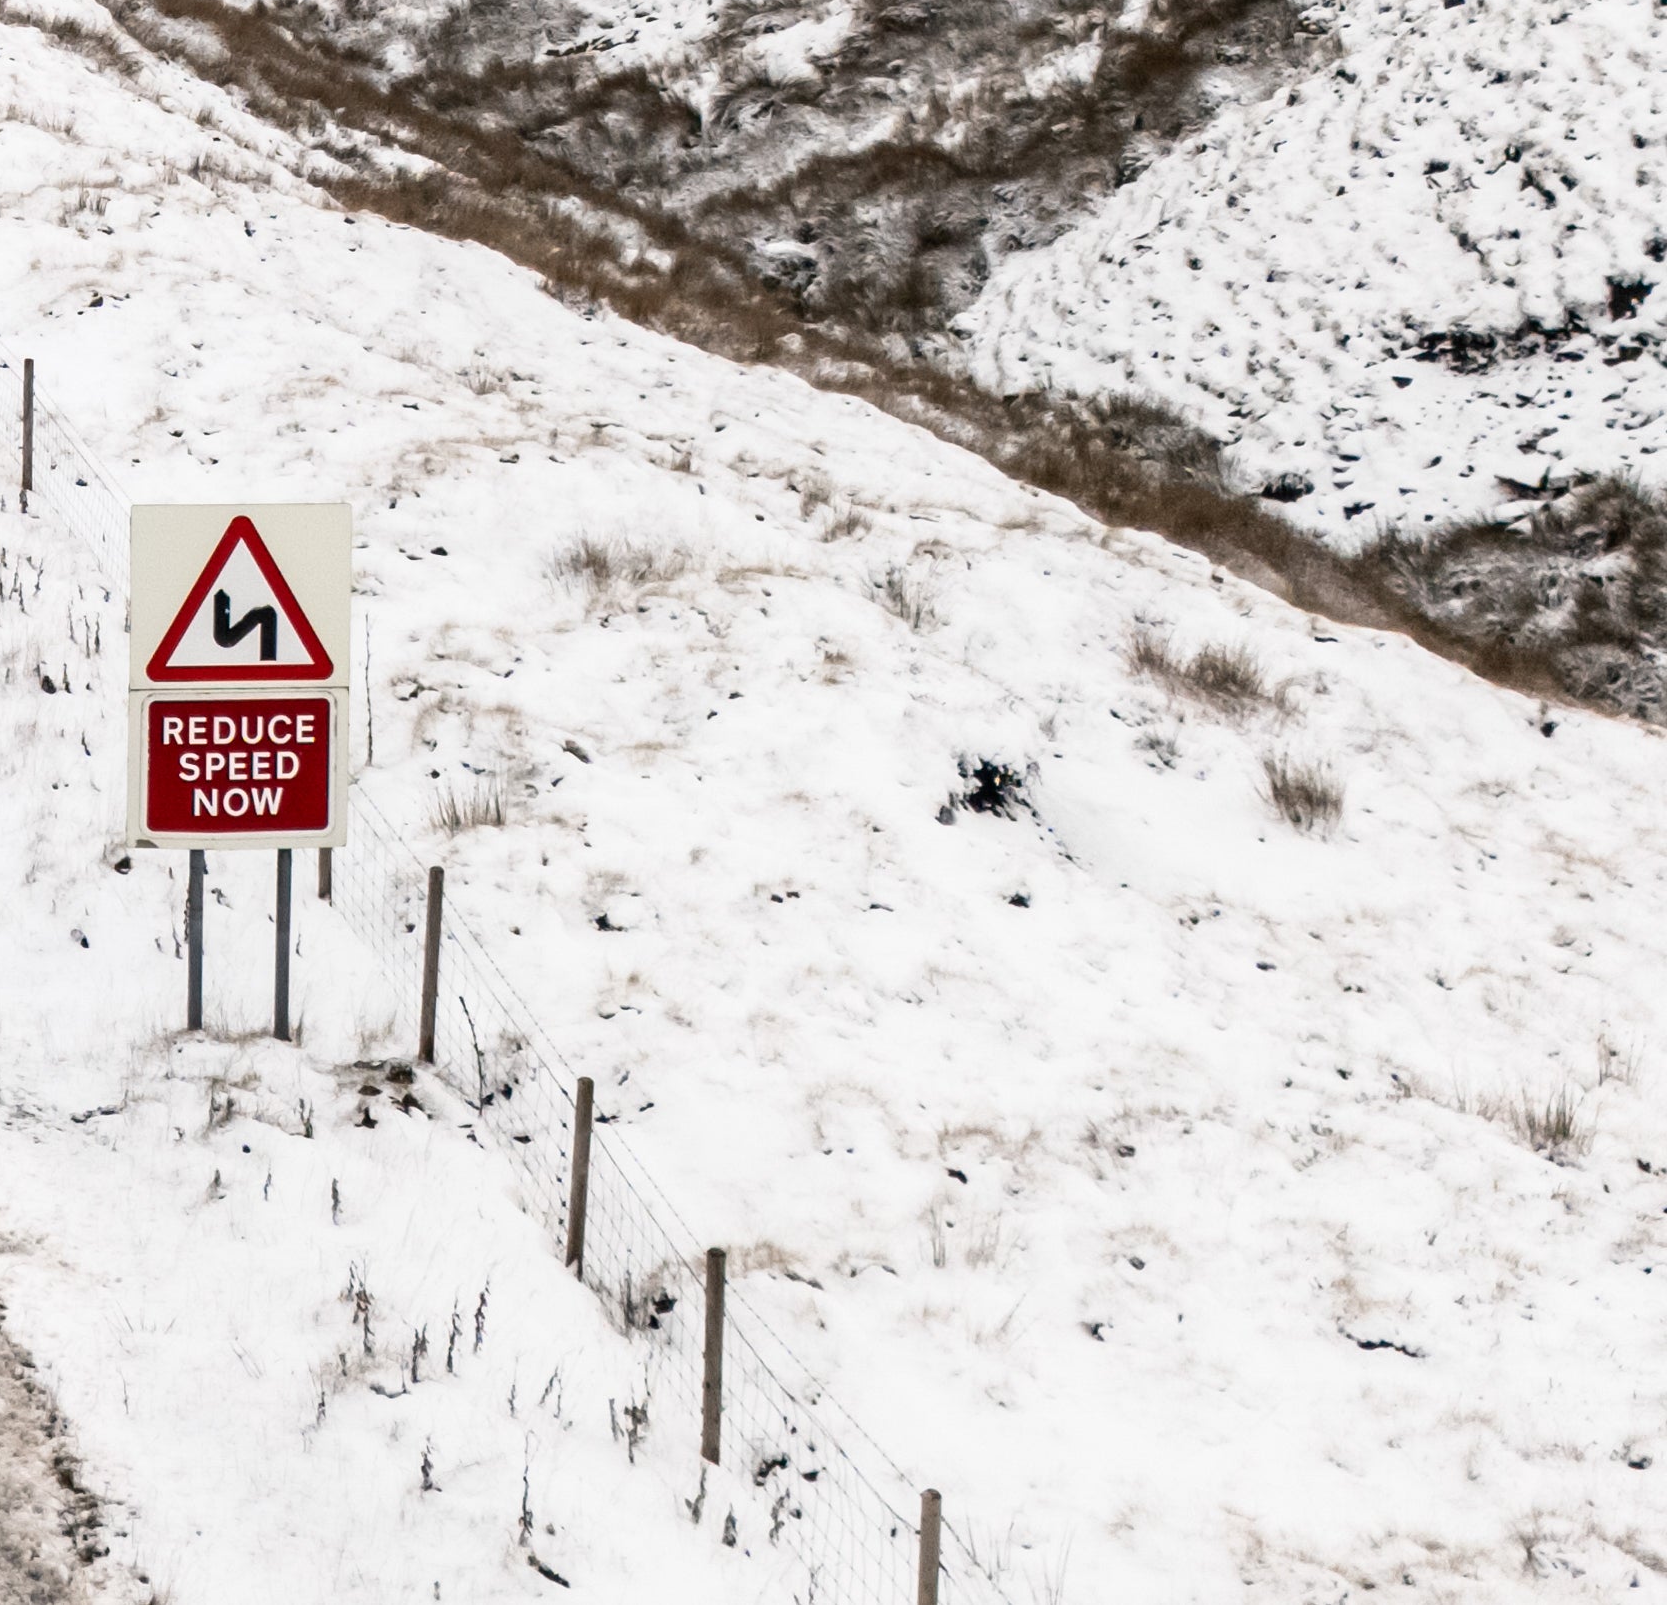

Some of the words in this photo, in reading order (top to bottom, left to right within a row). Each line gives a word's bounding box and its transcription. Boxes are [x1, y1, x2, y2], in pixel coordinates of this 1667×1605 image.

[162, 714, 315, 745] REDUCE
[178, 750, 300, 781] SPEED
[193, 787, 283, 817] NOW
